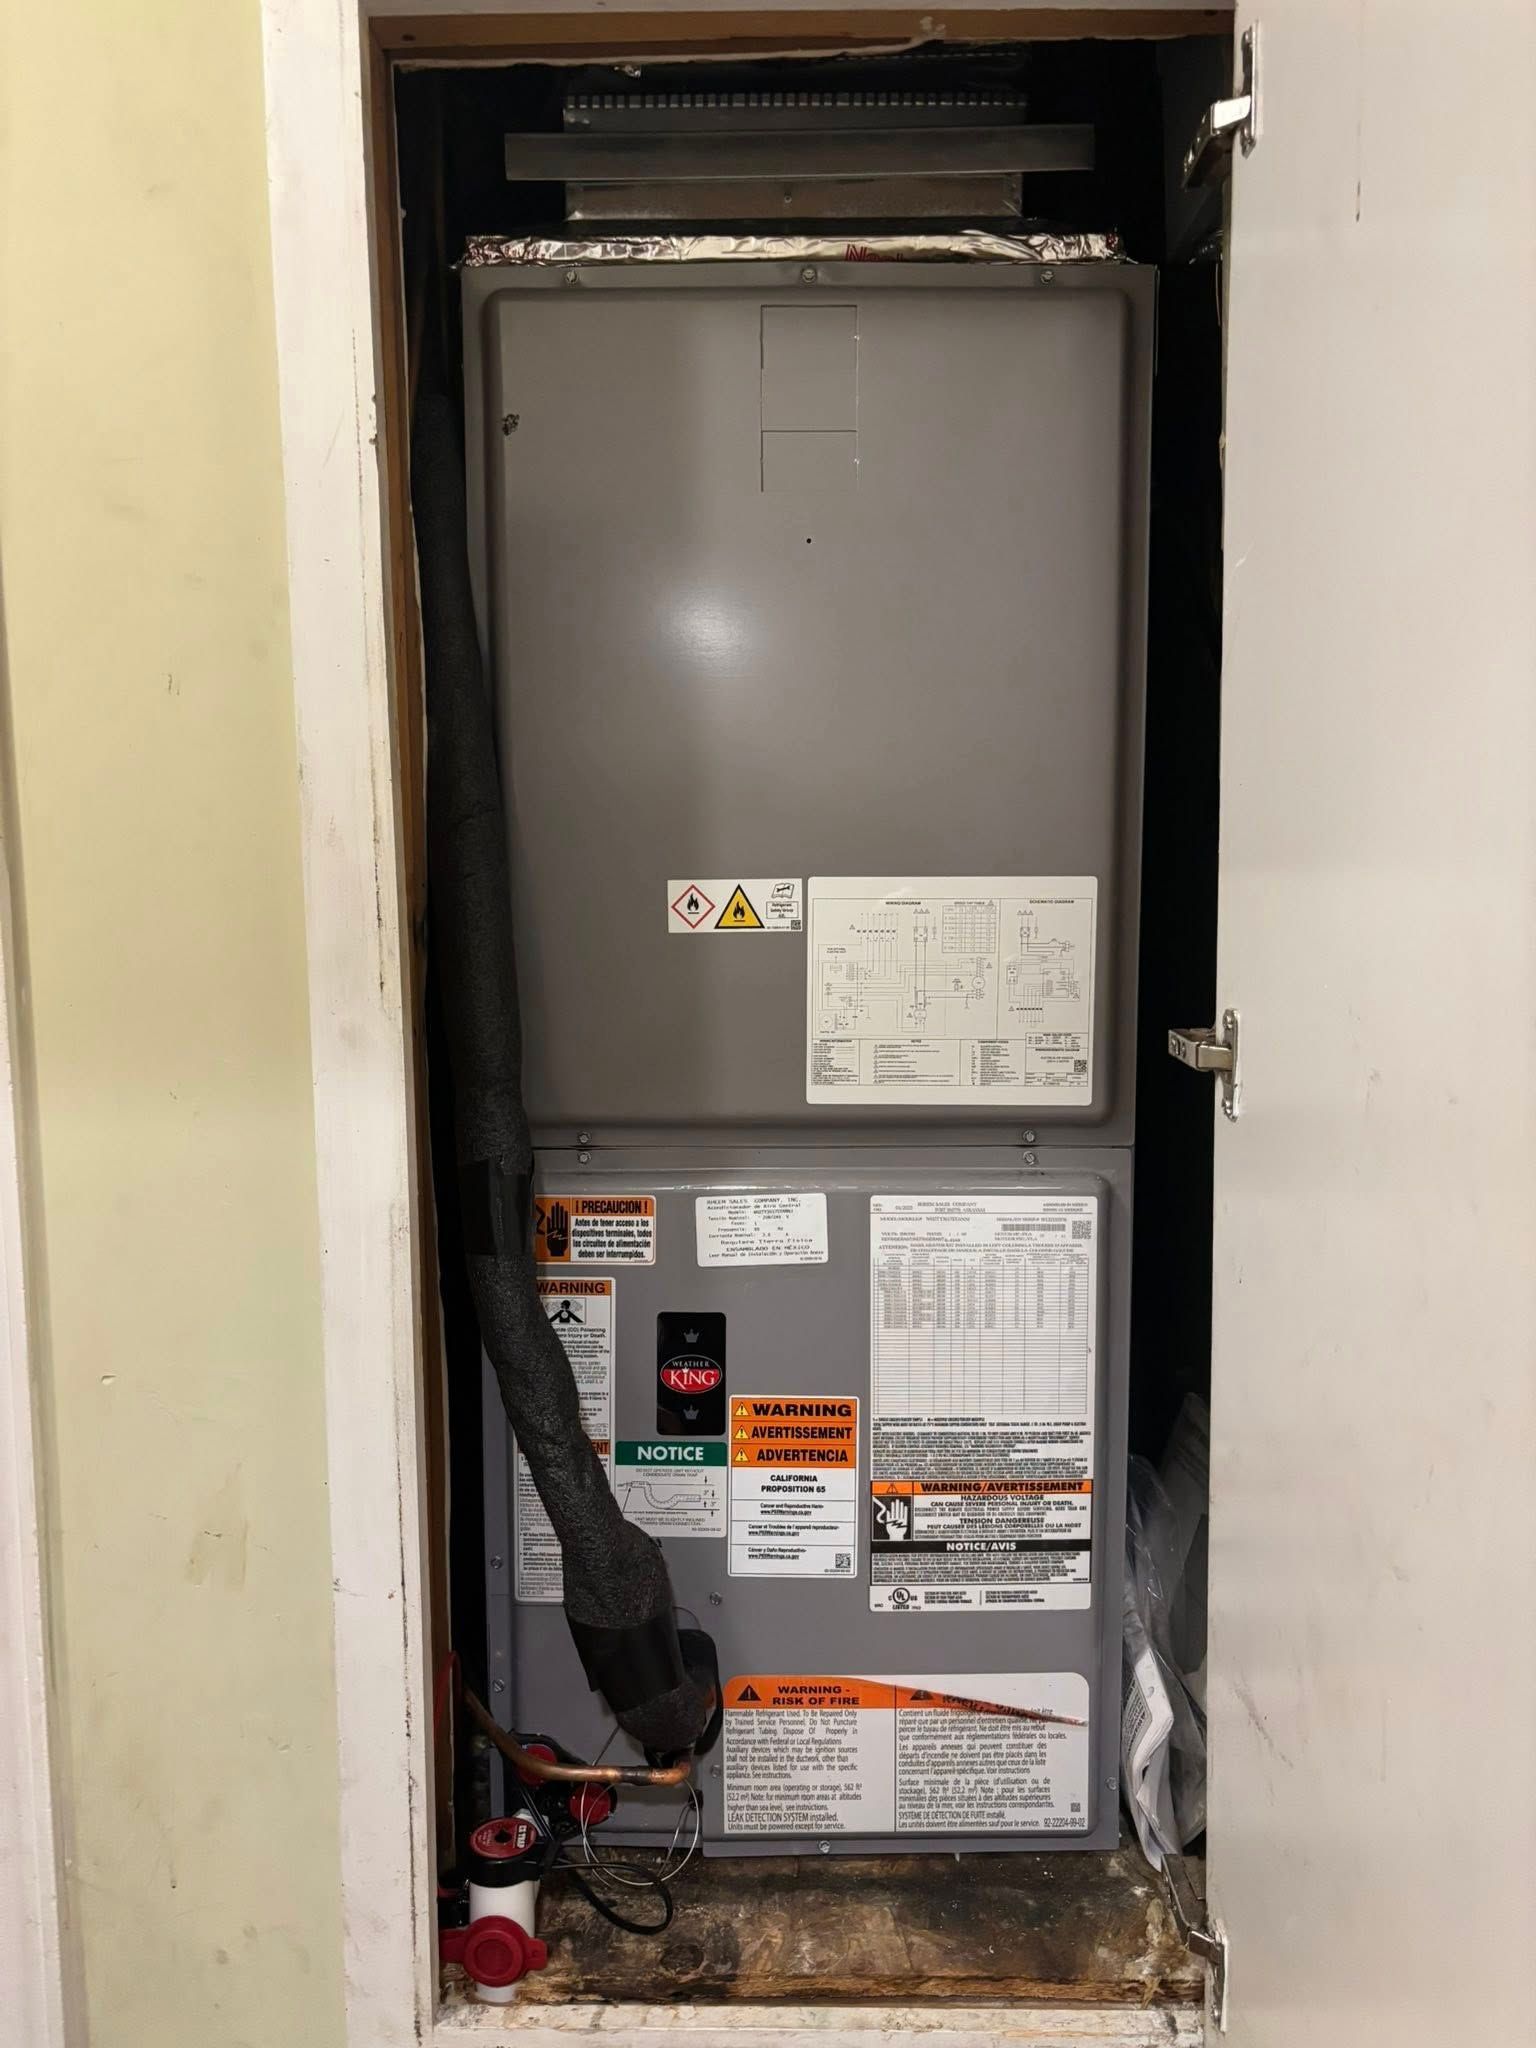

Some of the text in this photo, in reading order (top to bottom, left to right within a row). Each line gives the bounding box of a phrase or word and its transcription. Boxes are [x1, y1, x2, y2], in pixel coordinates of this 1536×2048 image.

[572, 1229, 604, 1238] dispositivos
[578, 1250, 594, 1258] deben
[606, 1250, 645, 1260] interrumpidos.
[536, 1282, 605, 1294] WARNING
[670, 1369, 715, 1390] KING
[752, 1404, 851, 1416] WARNING
[751, 1426, 852, 1439] AVERTISSEMENT
[637, 1446, 704, 1460] NOTICE
[757, 1449, 848, 1462] ADVERTENCIA
[921, 1482, 1084, 1492] WARNING/AVERTISSEMENT
[946, 1542, 1017, 1551] NOTICE/AVIS
[756, 1710, 785, 1719] Refrigerant
[820, 1710, 843, 1719] Repaired
[845, 1710, 857, 1719] Only
[726, 1728, 754, 1736] Refrigerant
[783, 1728, 804, 1736] Dispose
[826, 1728, 847, 1736] Properly
[812, 1738, 842, 1746] Regulations
[727, 1813, 838, 1822] LEAK DETECTION SYSTEM installed.
[1044, 1818, 1086, 1827] 92-22204-99-02
